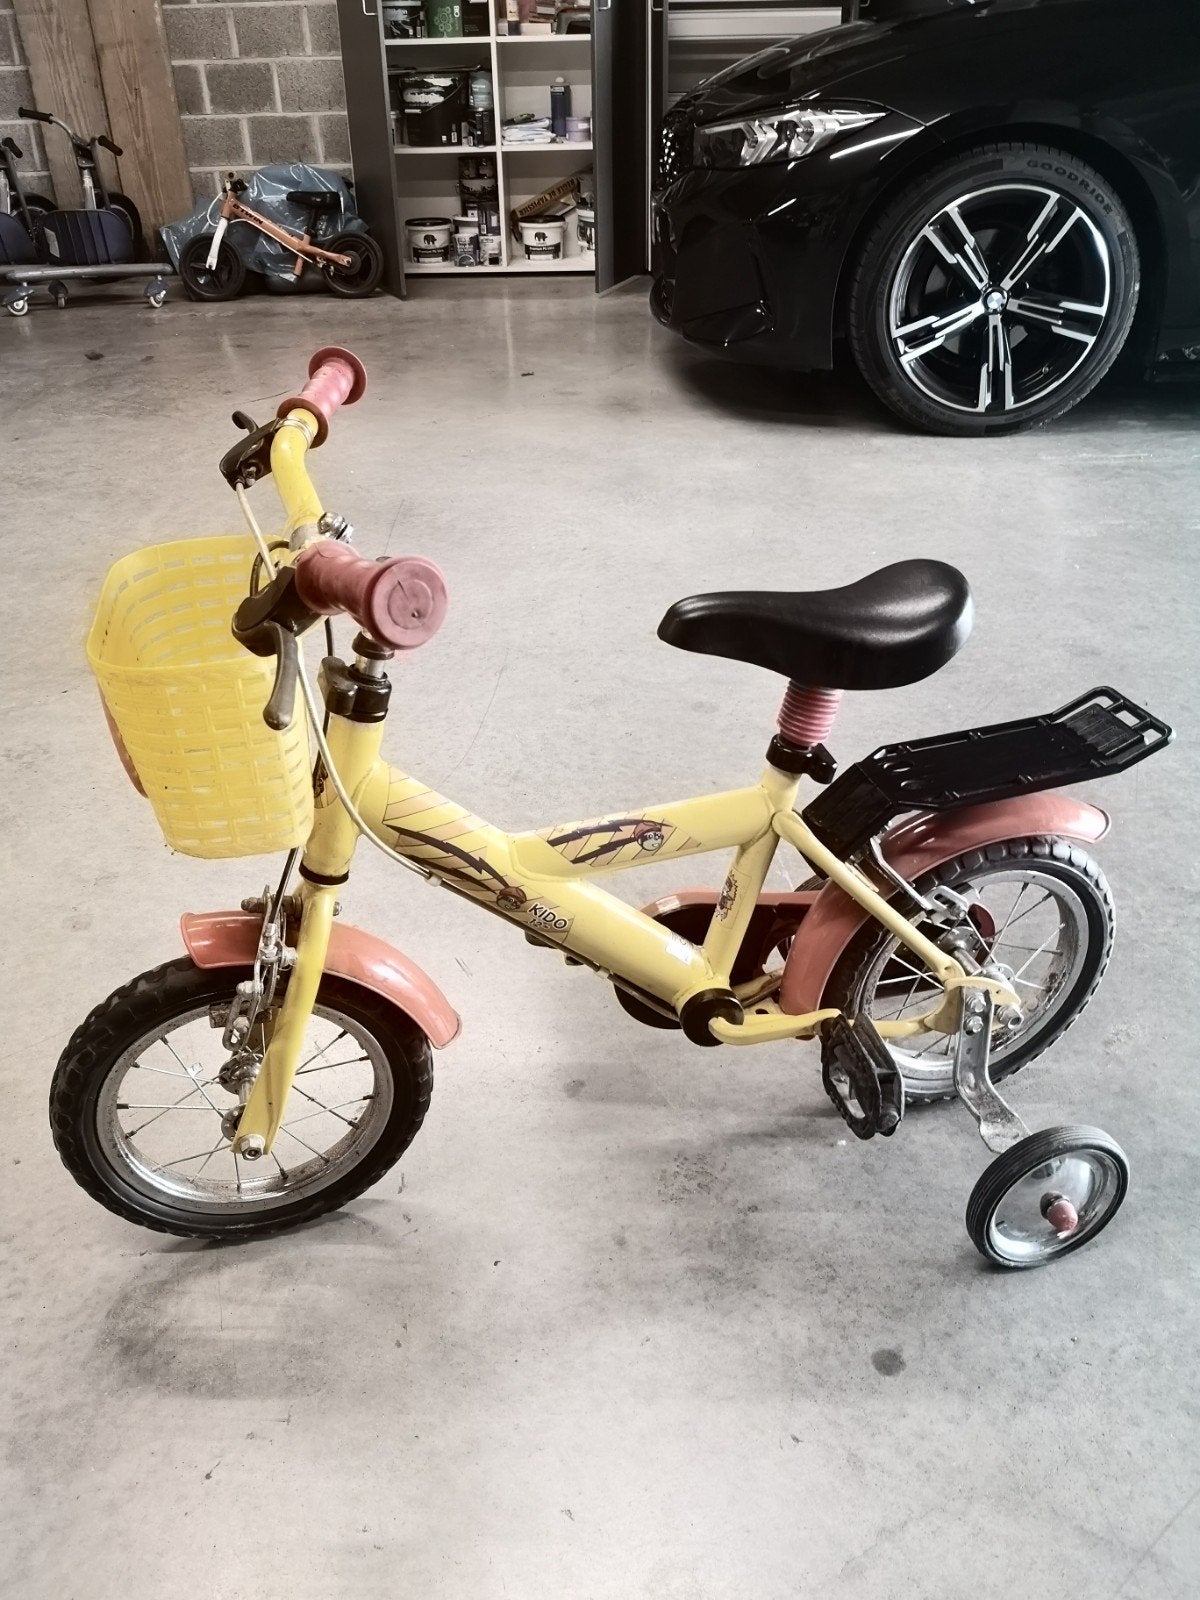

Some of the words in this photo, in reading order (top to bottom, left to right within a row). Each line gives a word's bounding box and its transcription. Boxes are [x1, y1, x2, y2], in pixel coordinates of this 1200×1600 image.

[1026, 160, 1113, 215] GOODRIDE
[519, 196, 549, 217] TAPISSIER
[528, 903, 568, 929] KIDO
